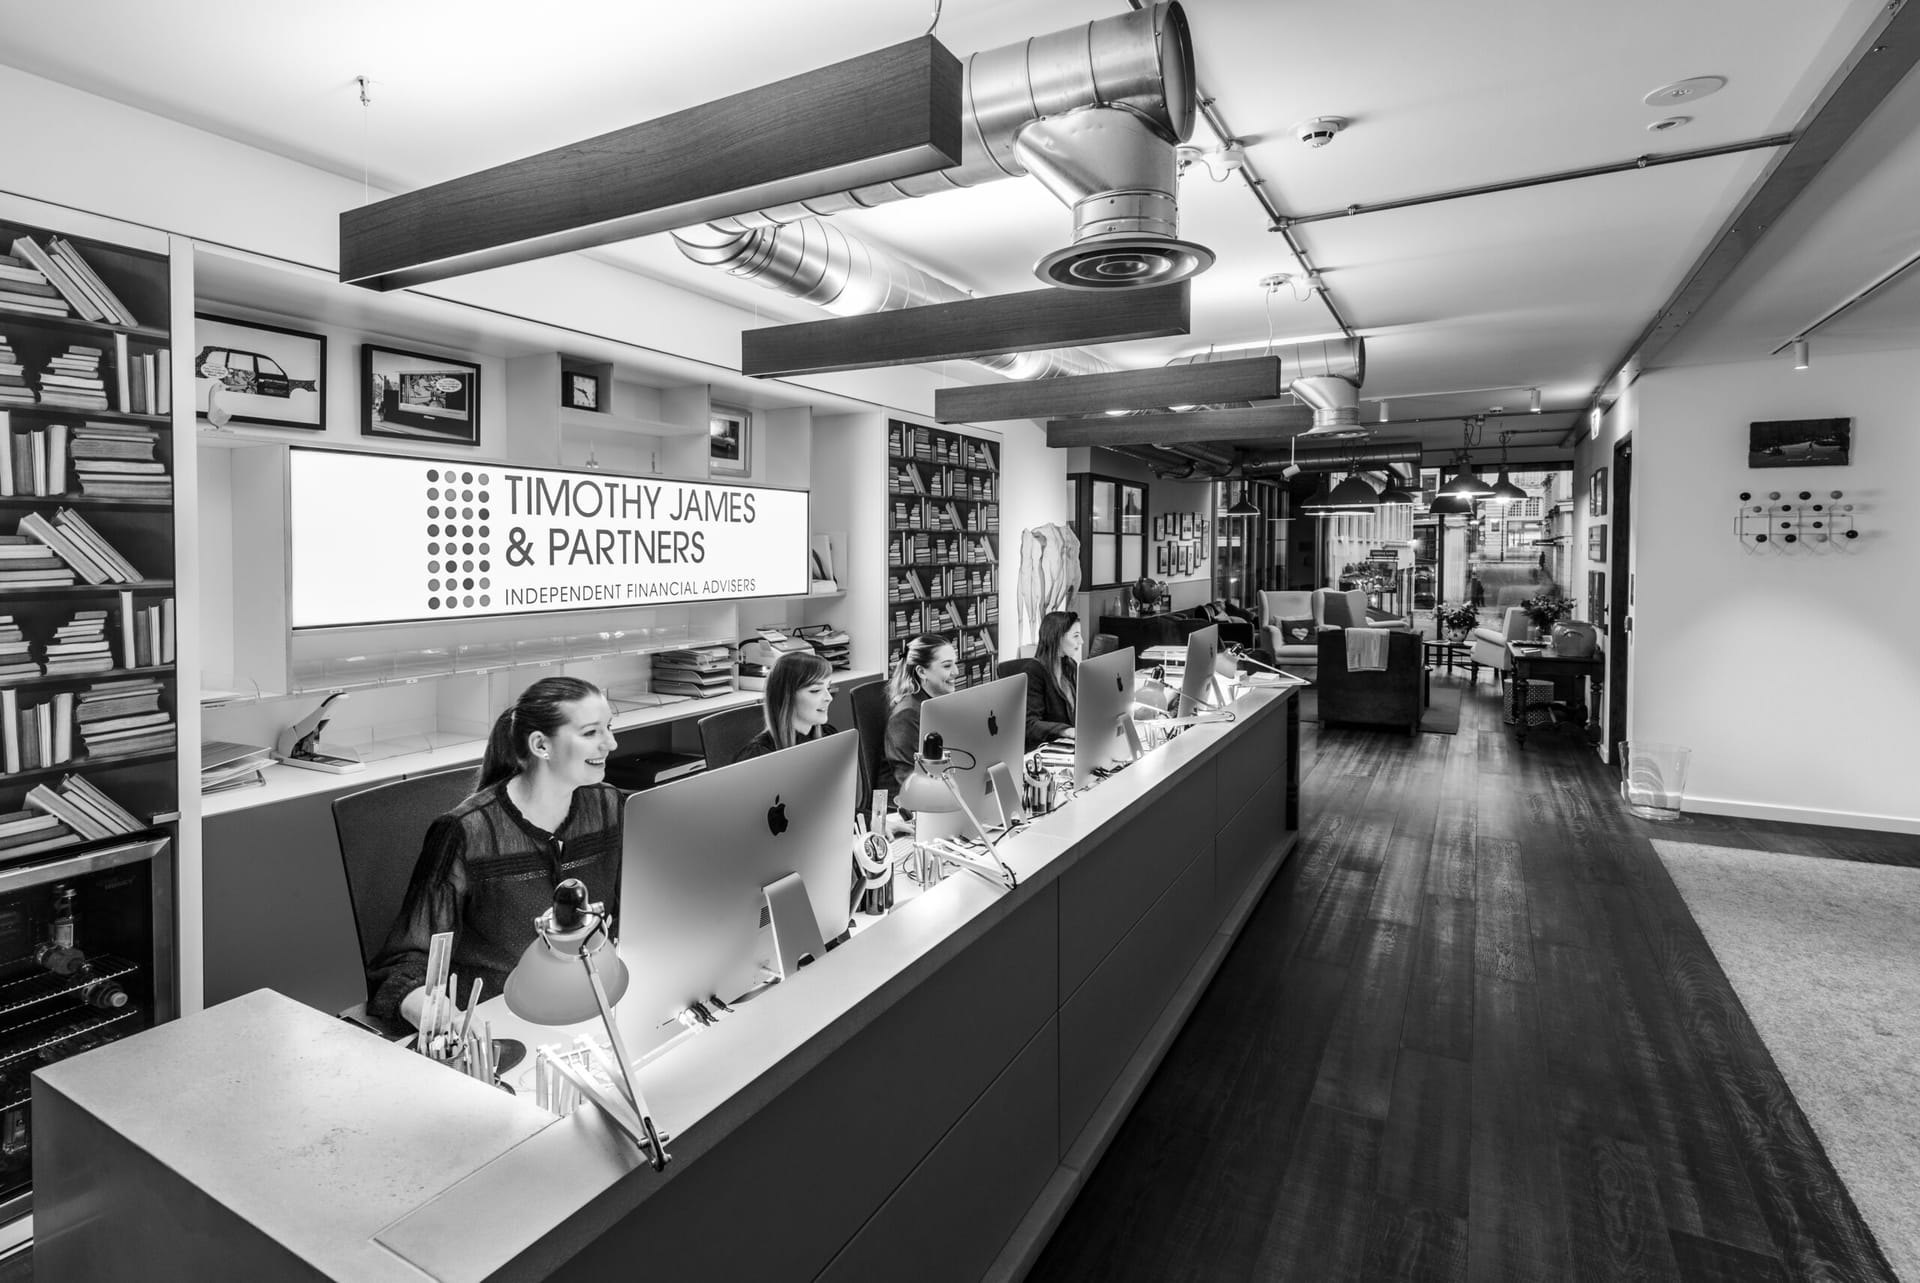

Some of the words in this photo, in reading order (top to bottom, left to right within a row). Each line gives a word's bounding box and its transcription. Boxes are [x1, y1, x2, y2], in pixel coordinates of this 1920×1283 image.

[504, 474, 662, 520] TIMOTHY
[669, 488, 756, 524] JAMES
[505, 526, 536, 568] &
[548, 527, 706, 566] PARTNERS
[505, 583, 622, 606] INDEPENDENT
[626, 581, 699, 599] FINANCIAL
[702, 578, 756, 594] ADVISERS
